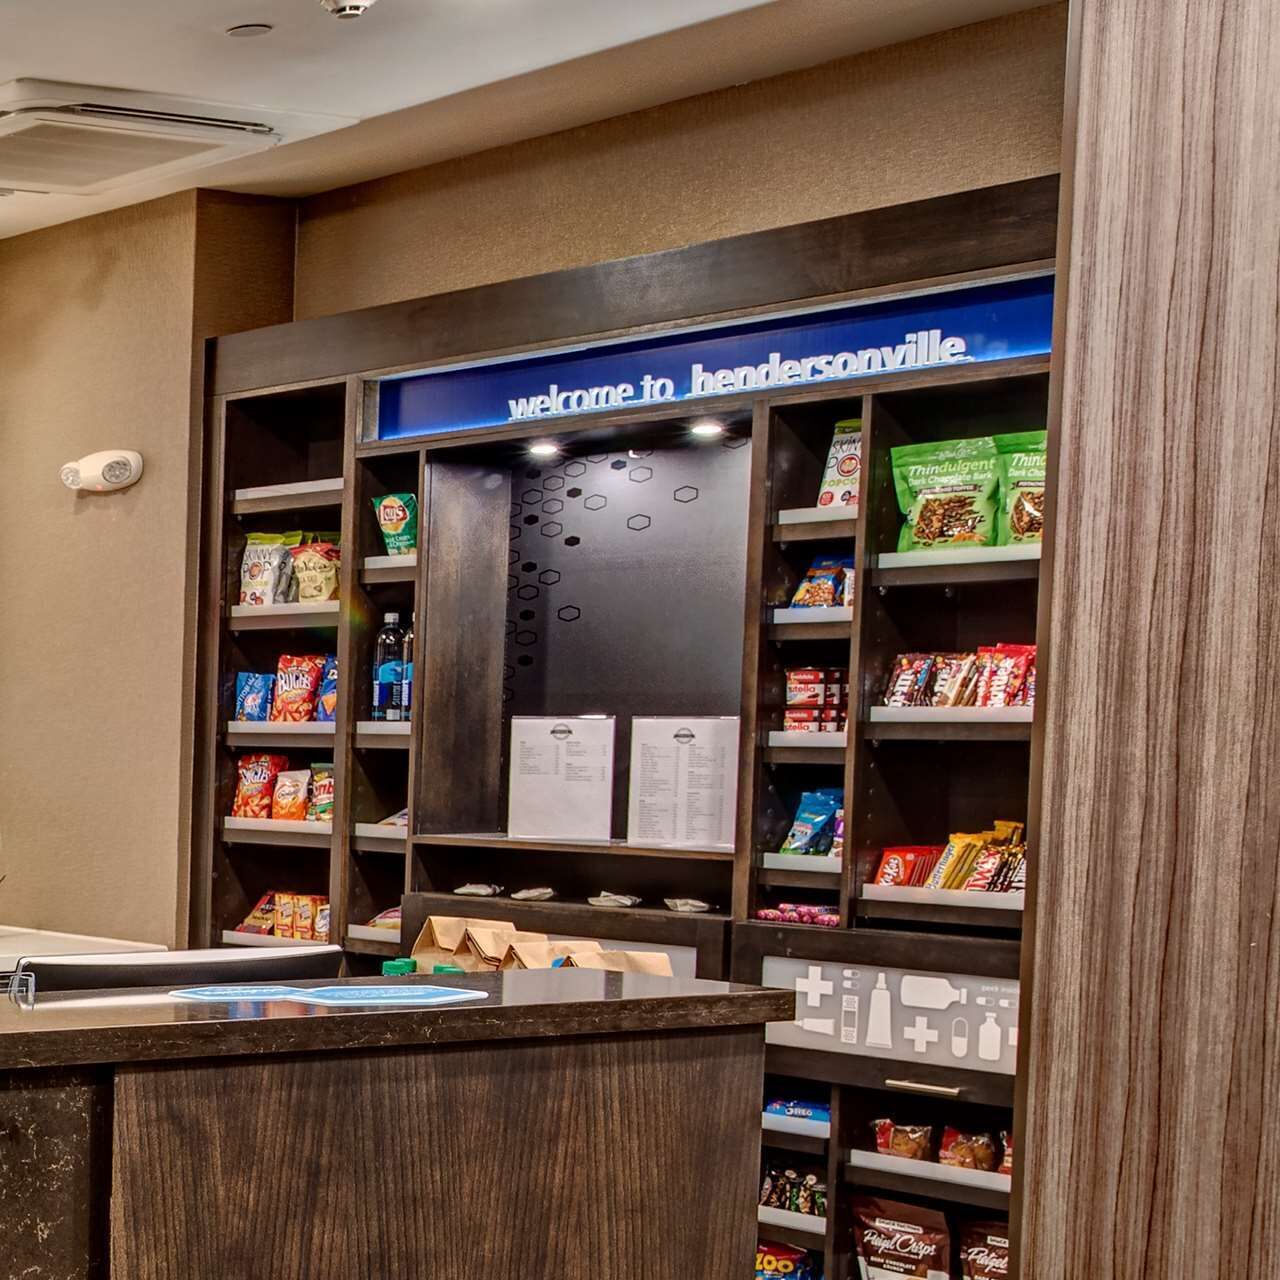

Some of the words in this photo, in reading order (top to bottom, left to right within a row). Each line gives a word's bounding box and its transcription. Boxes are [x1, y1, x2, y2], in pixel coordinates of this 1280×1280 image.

[508, 384, 634, 420] welcome
[640, 374, 674, 401] to
[691, 330, 968, 398] hendersonville
[785, 1107, 813, 1116] OREO
